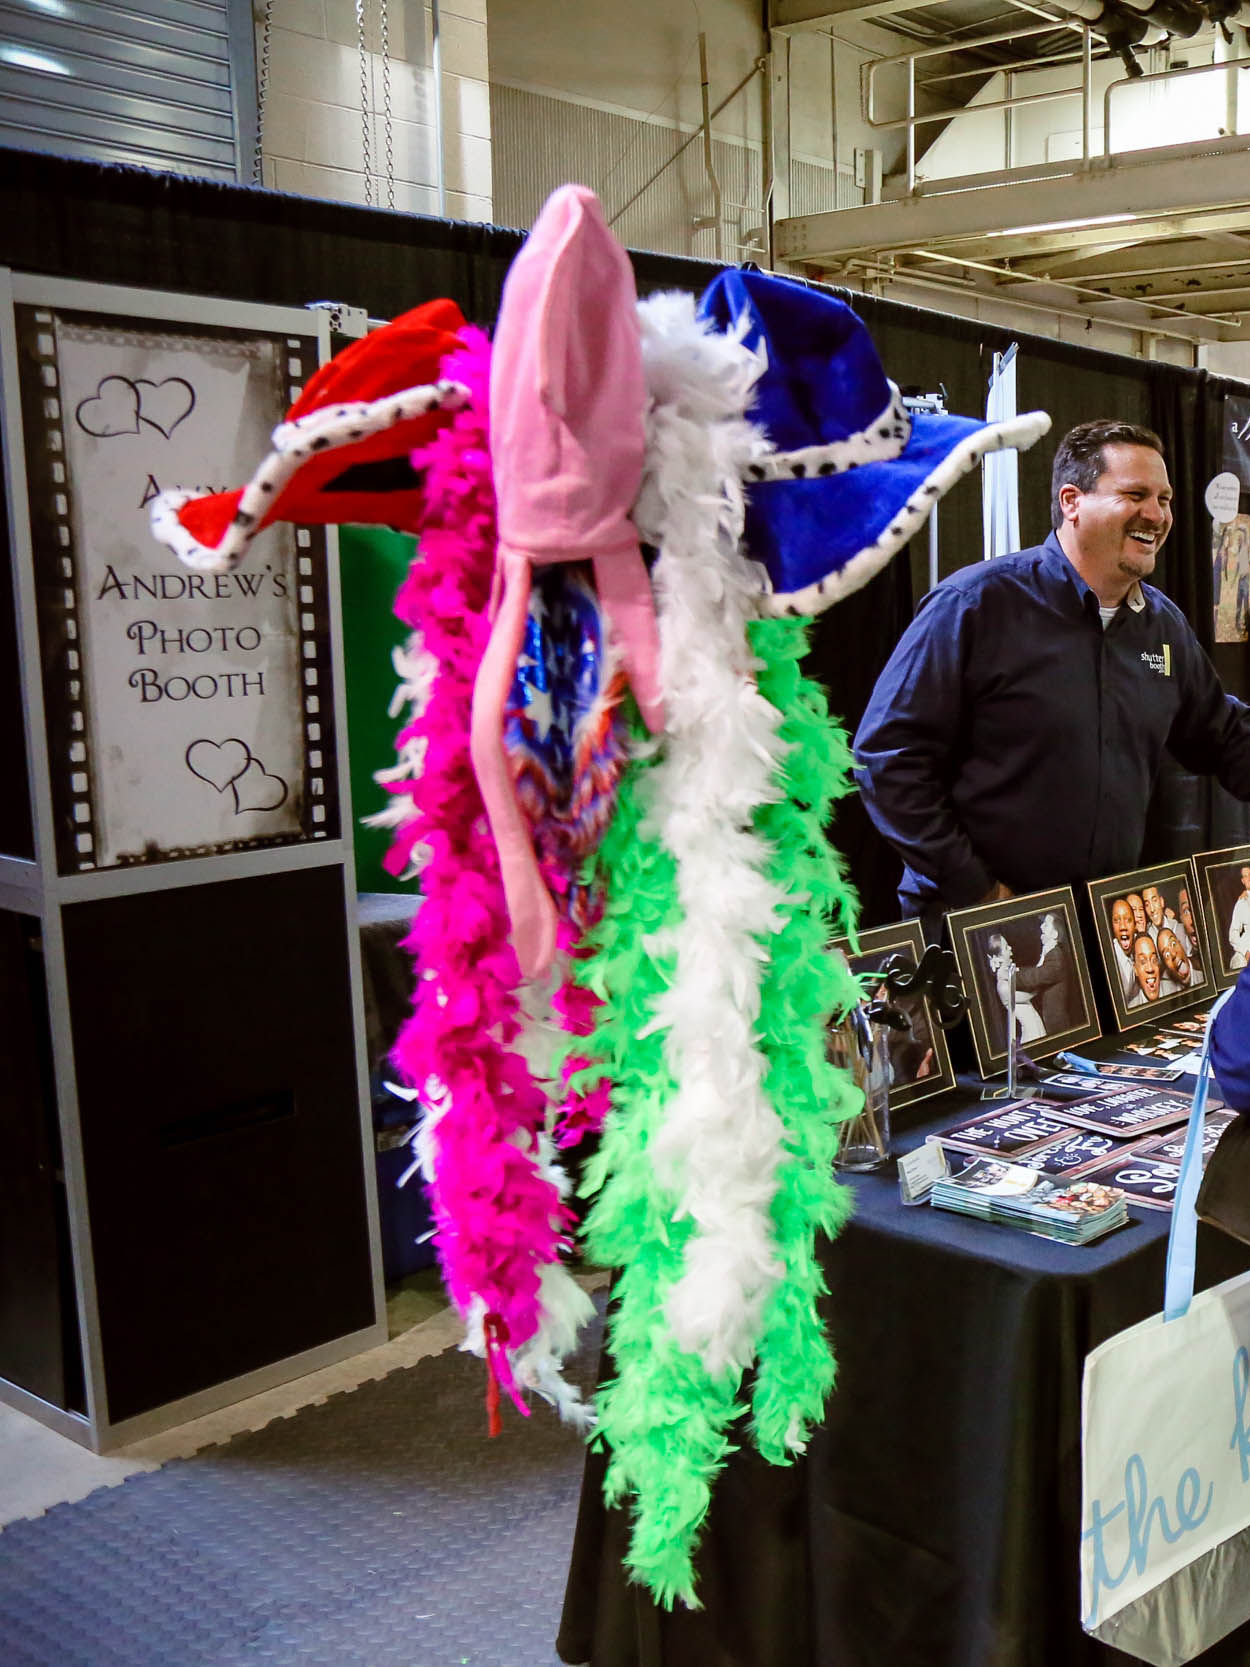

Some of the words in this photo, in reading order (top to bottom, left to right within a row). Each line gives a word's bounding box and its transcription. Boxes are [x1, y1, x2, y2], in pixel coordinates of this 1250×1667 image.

[1231, 421, 1239, 433] a
[96, 565, 288, 600] ANDREW'S
[127, 620, 262, 655] PHOTO
[128, 668, 265, 703] BOOTH
[950, 1126, 994, 1140] THE
[984, 1110, 1036, 1129] HUNT
[1081, 1453, 1214, 1630] the
